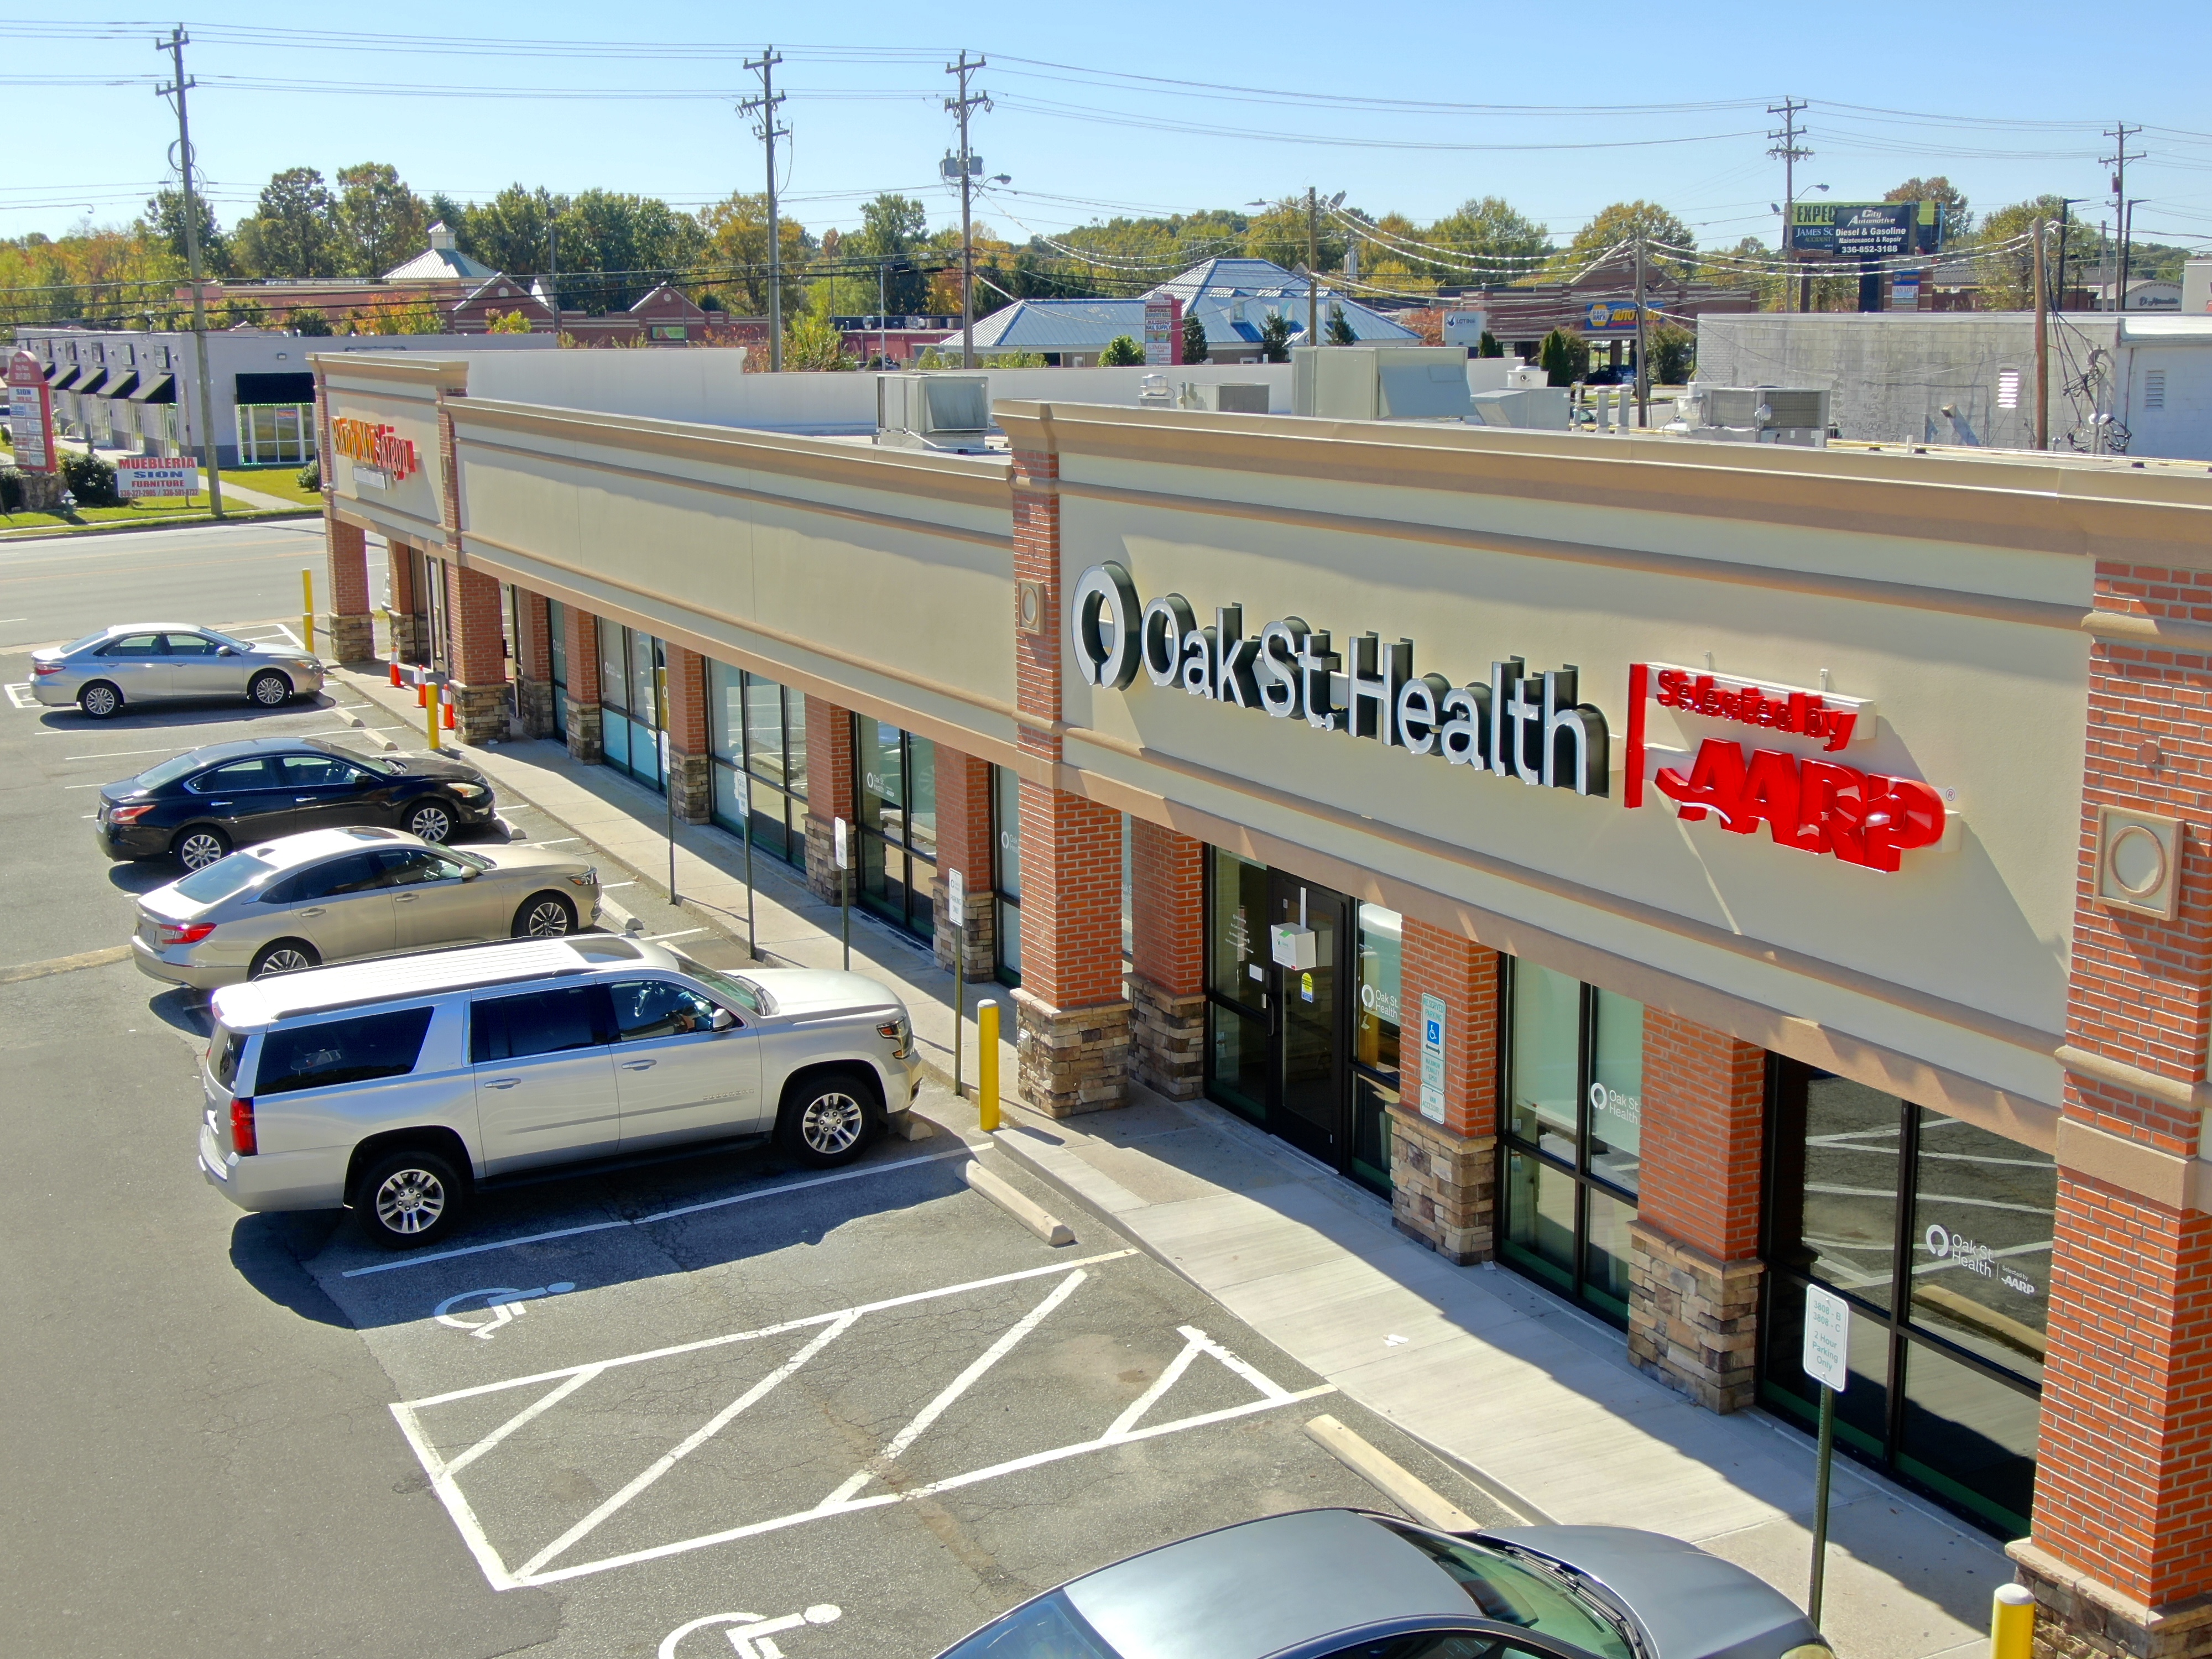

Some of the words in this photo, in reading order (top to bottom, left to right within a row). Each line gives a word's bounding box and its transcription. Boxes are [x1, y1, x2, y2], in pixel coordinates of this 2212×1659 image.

[1797, 205, 1844, 222] EXPEC
[1847, 215, 1896, 227] Automotive
[1862, 209, 1882, 218] City
[1796, 227, 1822, 237] JAMES
[1836, 228, 1859, 236] Diesel
[1861, 227, 1868, 236] &
[1870, 226, 1906, 235] Gasoline
[1841, 245, 1898, 253] 336-852-3188
[1611, 309, 1637, 321] AUTO
[1141, 595, 1260, 708] Oak
[1348, 633, 1606, 797] Health
[1657, 669, 1806, 734] Selected
[1804, 694, 1857, 753] by
[1655, 738, 1945, 873] AARP
[1375, 989, 1389, 1004] Oak
[1375, 1000, 1397, 1019] Health
[1423, 998, 1444, 1013] RESERVED
[1425, 1008, 1442, 1022] PARKING
[1425, 1065, 1439, 1076] PENALTY
[1609, 1089, 1627, 1107] Oak
[1422, 1100, 1443, 1116] ACCESSIBLE
[1609, 1102, 1637, 1125] Health
[1953, 1234, 1976, 1256] Oak
[1952, 1248, 1991, 1277] Health
[2002, 1265, 2022, 1279] Selected
[2023, 1274, 2029, 1282] by
[2001, 1275, 2035, 1295] AARP
[1814, 1300, 1830, 1316] 3808
[1836, 1311, 1841, 1321] B
[1813, 1311, 1829, 1327] 3808
[1835, 1323, 1840, 1333] C
[1814, 1331, 1819, 1339] 2
[1820, 1333, 1838, 1349] Hour
[1812, 1340, 1839, 1364] Parking
[1817, 1355, 1833, 1372] Only
